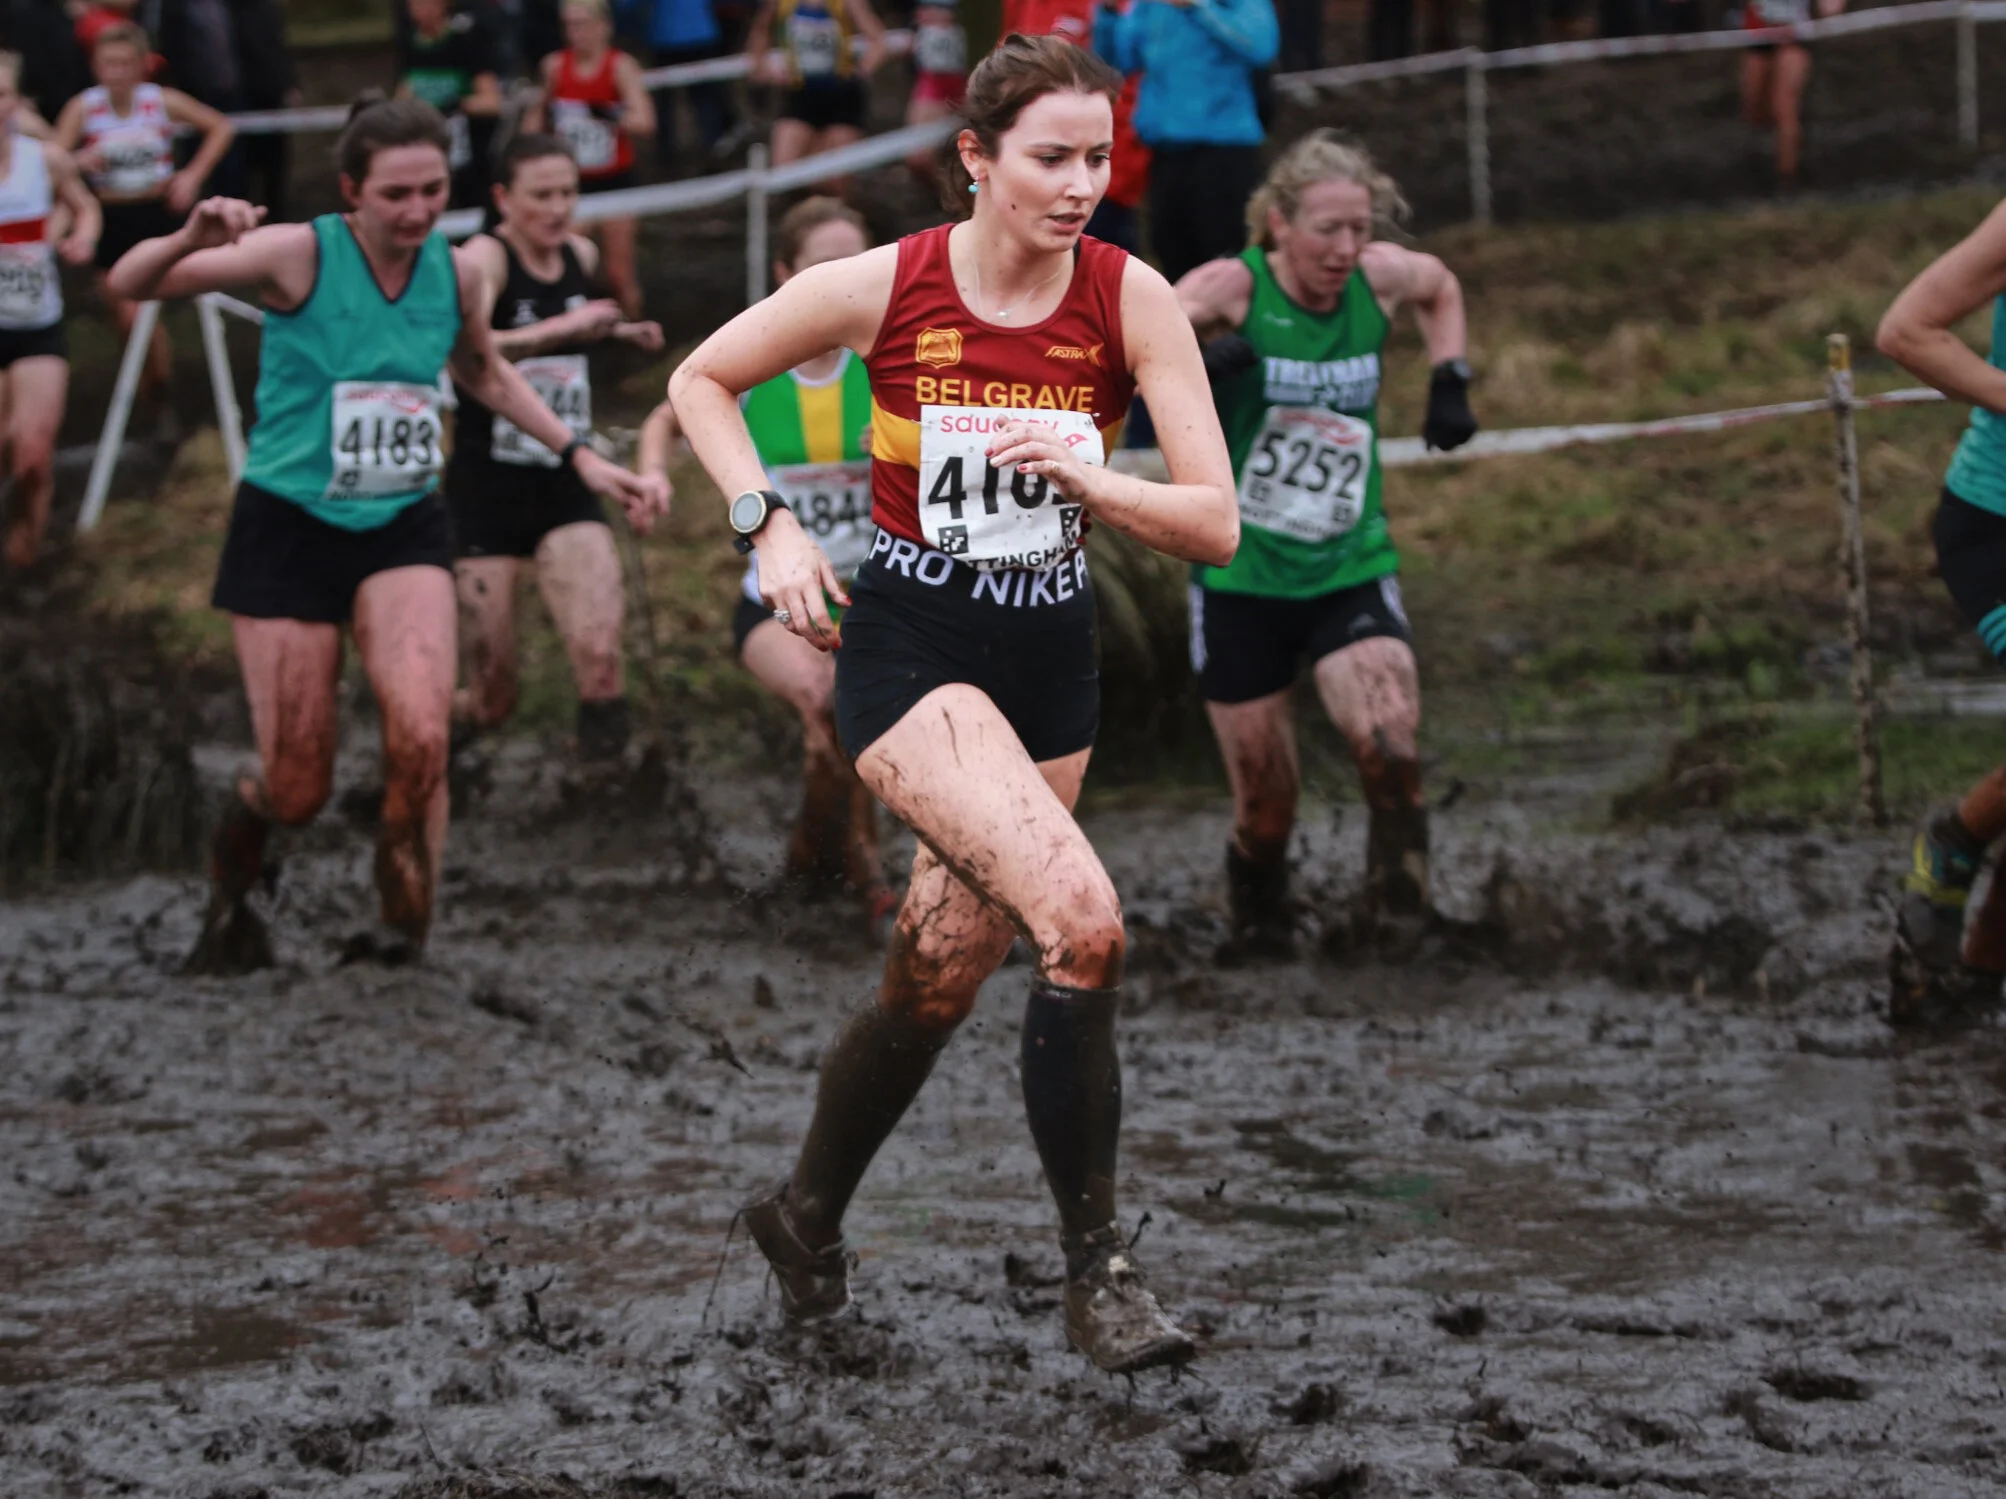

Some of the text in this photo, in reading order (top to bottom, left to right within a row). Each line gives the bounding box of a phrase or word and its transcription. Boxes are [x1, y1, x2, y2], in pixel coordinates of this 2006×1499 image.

[915, 375, 1095, 413] BELGRAVE
[339, 417, 434, 466] 4183
[1252, 431, 1361, 500] 5252
[928, 456, 1070, 519] 410
[868, 527, 954, 586] PRO
[971, 561, 1074, 607] NIKE
